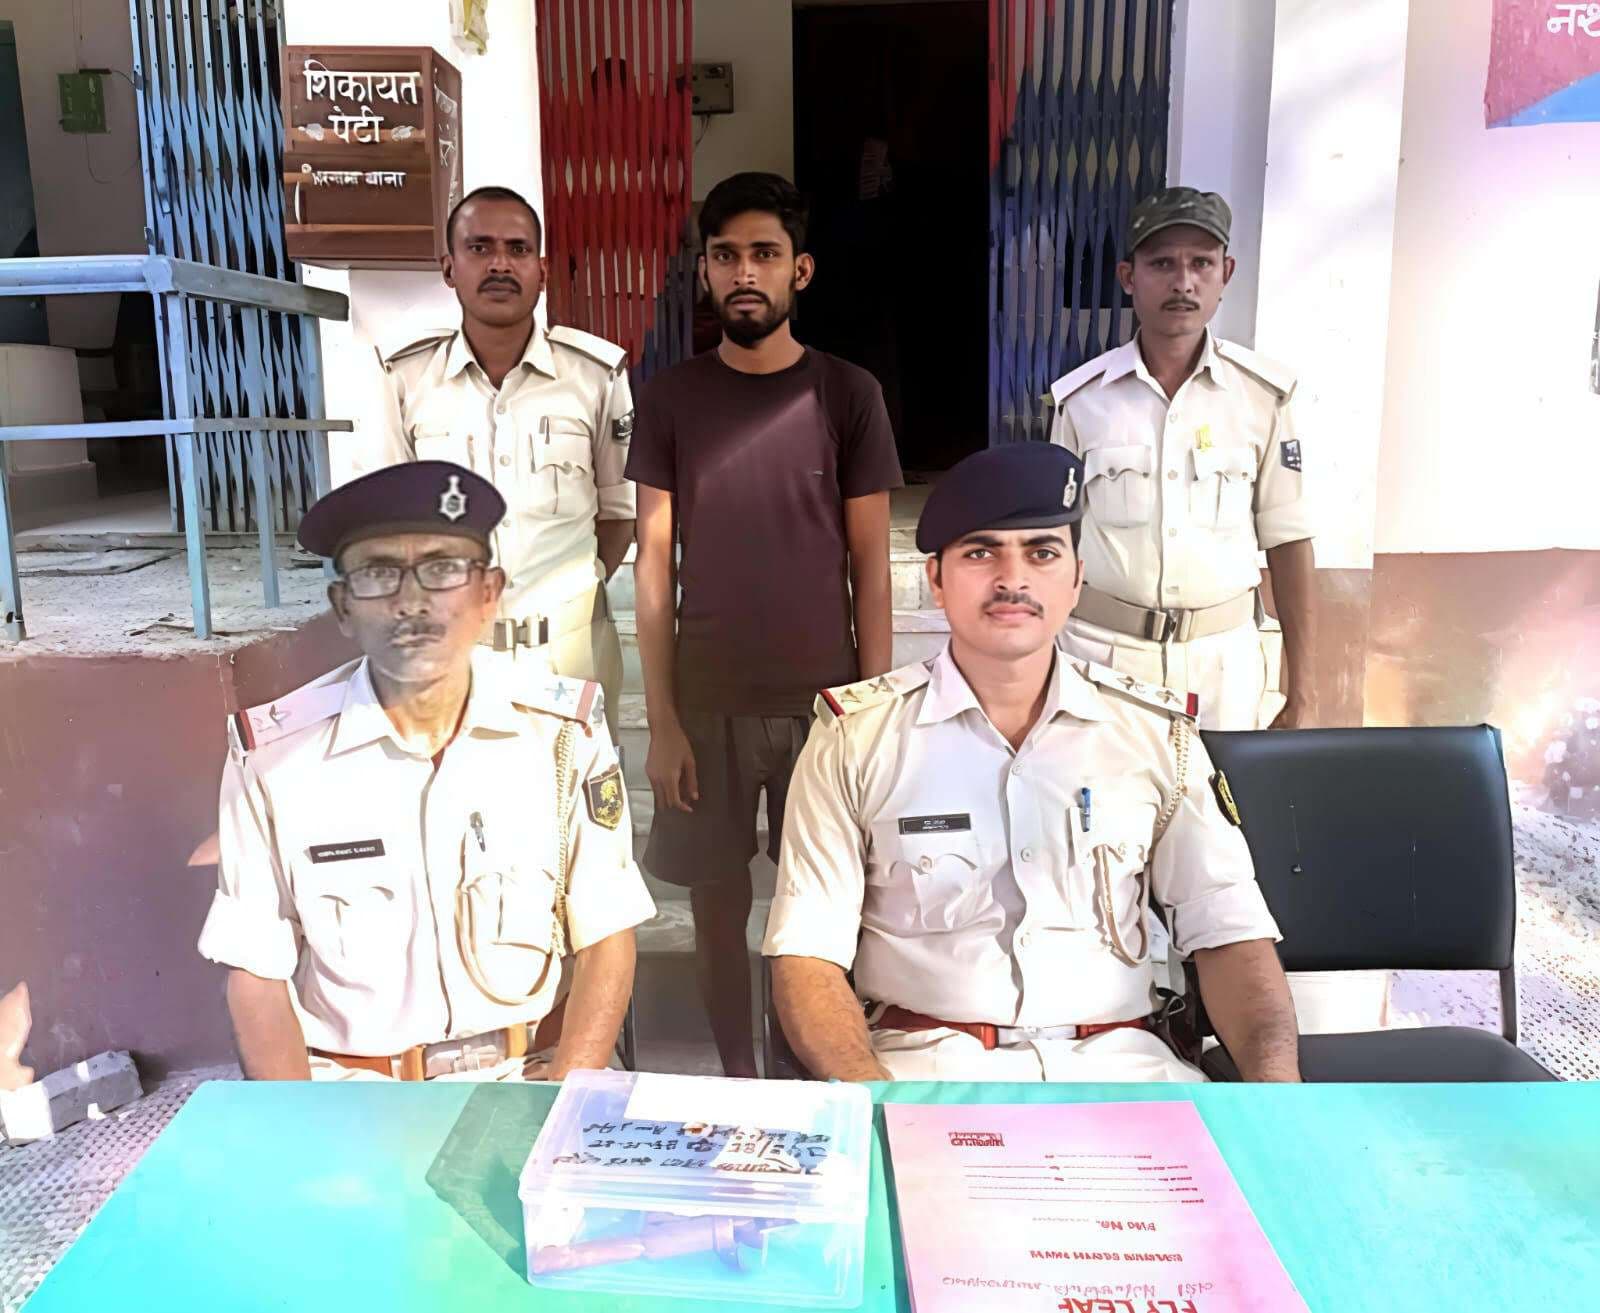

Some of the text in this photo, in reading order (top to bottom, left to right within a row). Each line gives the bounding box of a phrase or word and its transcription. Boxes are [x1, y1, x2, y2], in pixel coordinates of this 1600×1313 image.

[303, 58, 420, 104] शिकायत
[328, 105, 385, 143] पेटी
[1057, 1297, 1136, 1313] LEAF
